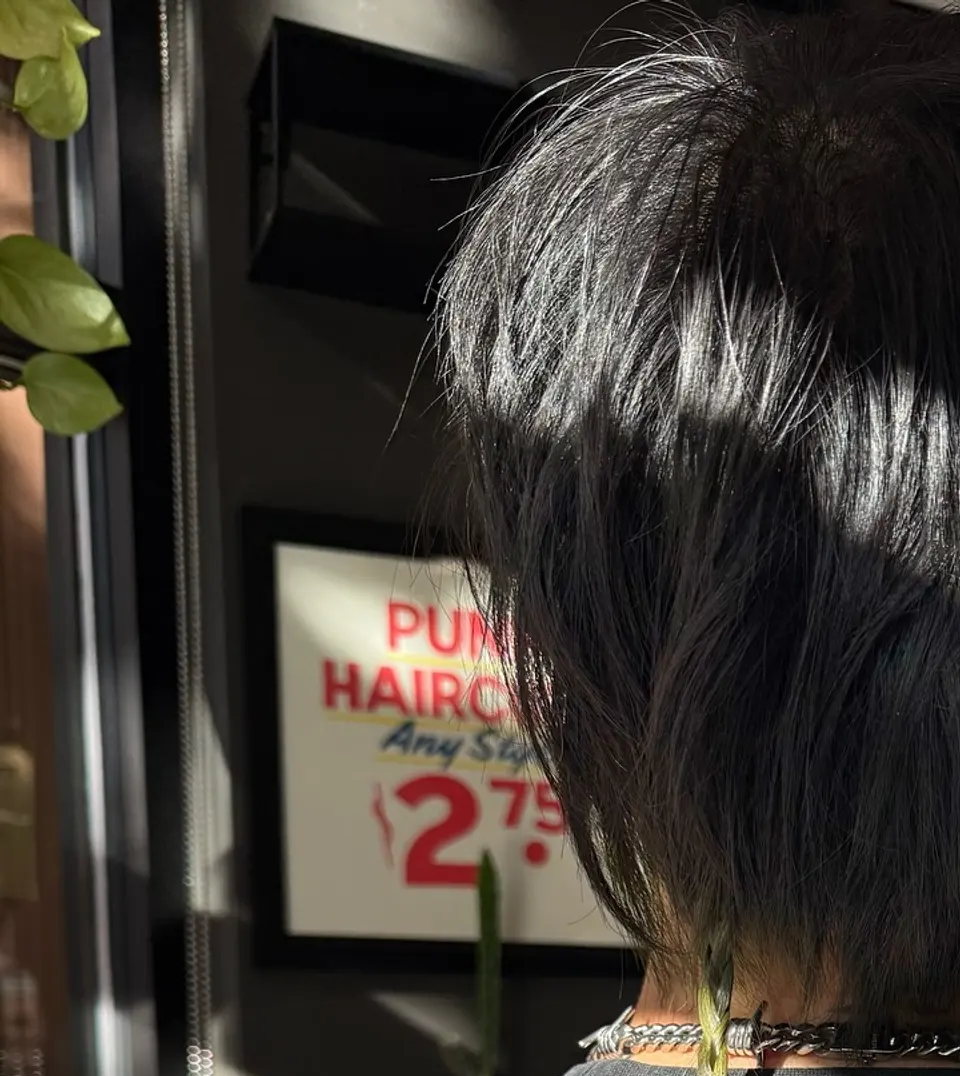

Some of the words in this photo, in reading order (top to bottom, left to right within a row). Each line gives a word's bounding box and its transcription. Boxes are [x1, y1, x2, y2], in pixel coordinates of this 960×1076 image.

[386, 601, 513, 659] PUN
[322, 657, 518, 724] HAIRC
[380, 719, 461, 771] Any
[466, 728, 539, 774] Sty
